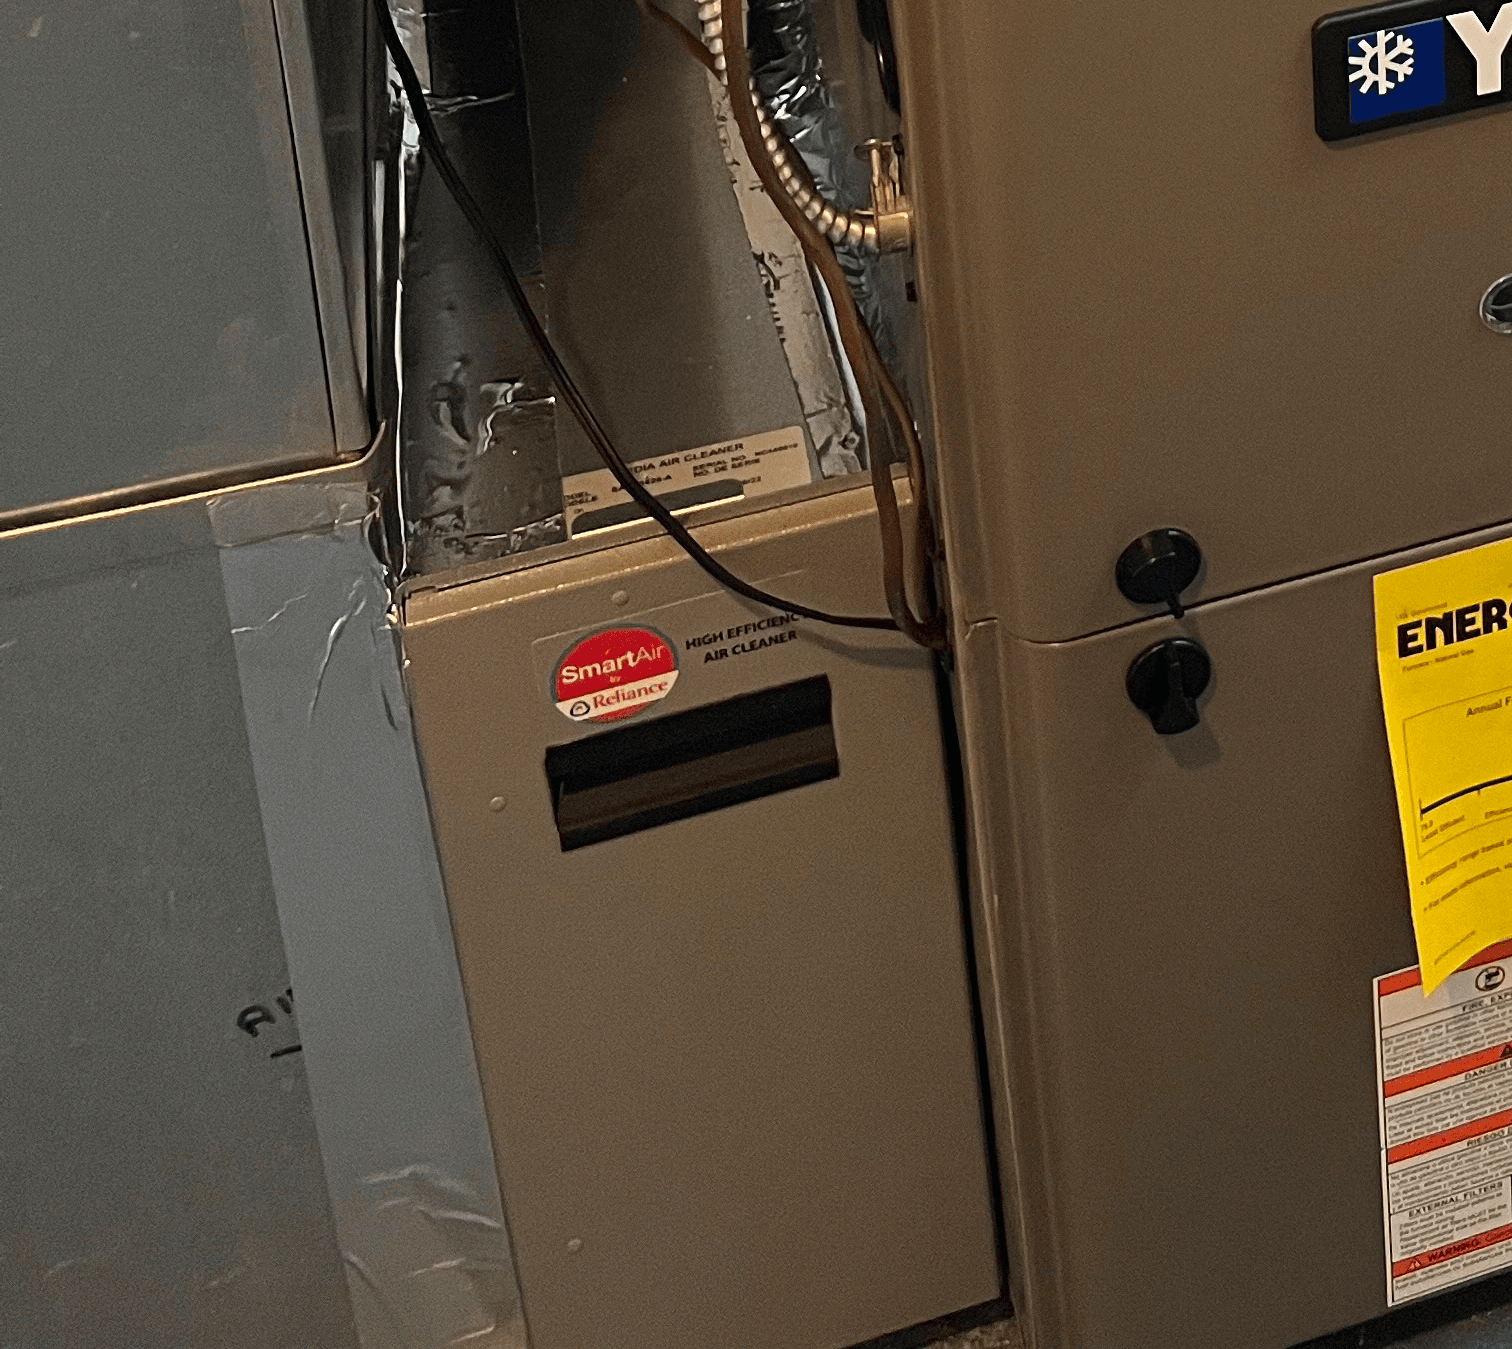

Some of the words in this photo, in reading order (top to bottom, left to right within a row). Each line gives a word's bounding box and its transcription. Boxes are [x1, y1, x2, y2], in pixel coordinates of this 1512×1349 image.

[659, 456, 680, 468] AIR
[684, 442, 744, 462] CLEANER
[714, 464, 728, 473] DE
[685, 632, 724, 650] HIGH
[727, 612, 802, 639] EFFICIENC
[703, 647, 729, 663] AIR
[732, 629, 798, 655] CLEANER
[561, 644, 666, 685] SmartAir
[593, 679, 669, 709] Reliance
[1466, 699, 1503, 717] Annual
[1408, 1194, 1459, 1218] EXTERNAL
[1462, 1180, 1503, 1200] FILTERS
